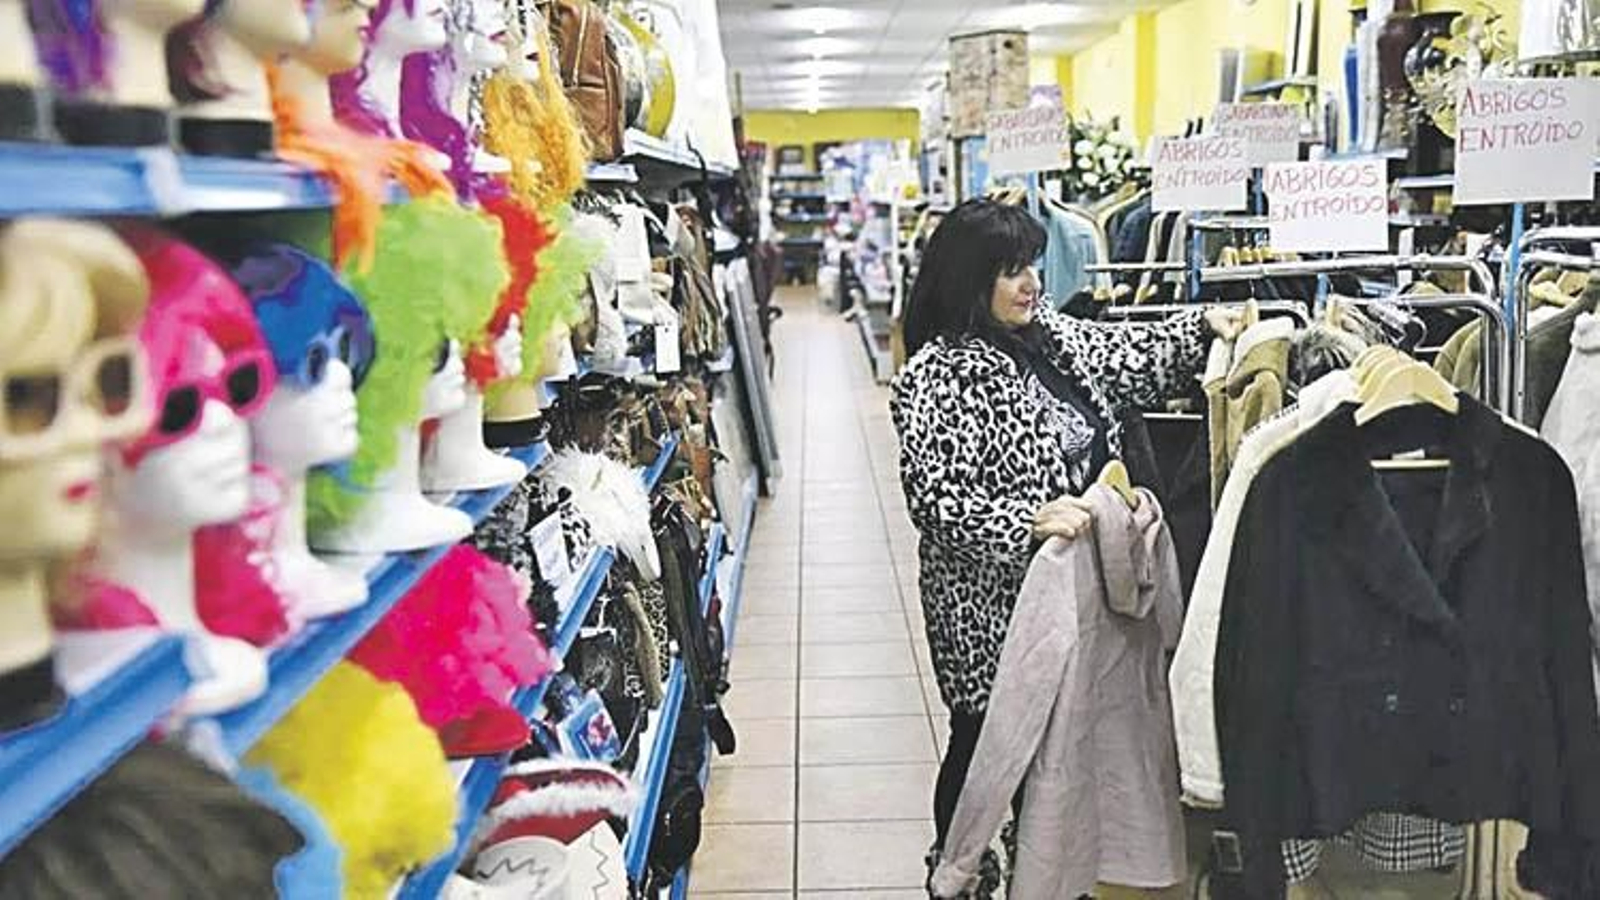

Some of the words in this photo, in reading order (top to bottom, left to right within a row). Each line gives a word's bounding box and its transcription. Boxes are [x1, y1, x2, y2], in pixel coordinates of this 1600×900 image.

[1459, 84, 1567, 118] ABRIGOS
[1159, 139, 1244, 163] ABRIGOS
[1266, 163, 1379, 194] ABRIGOS
